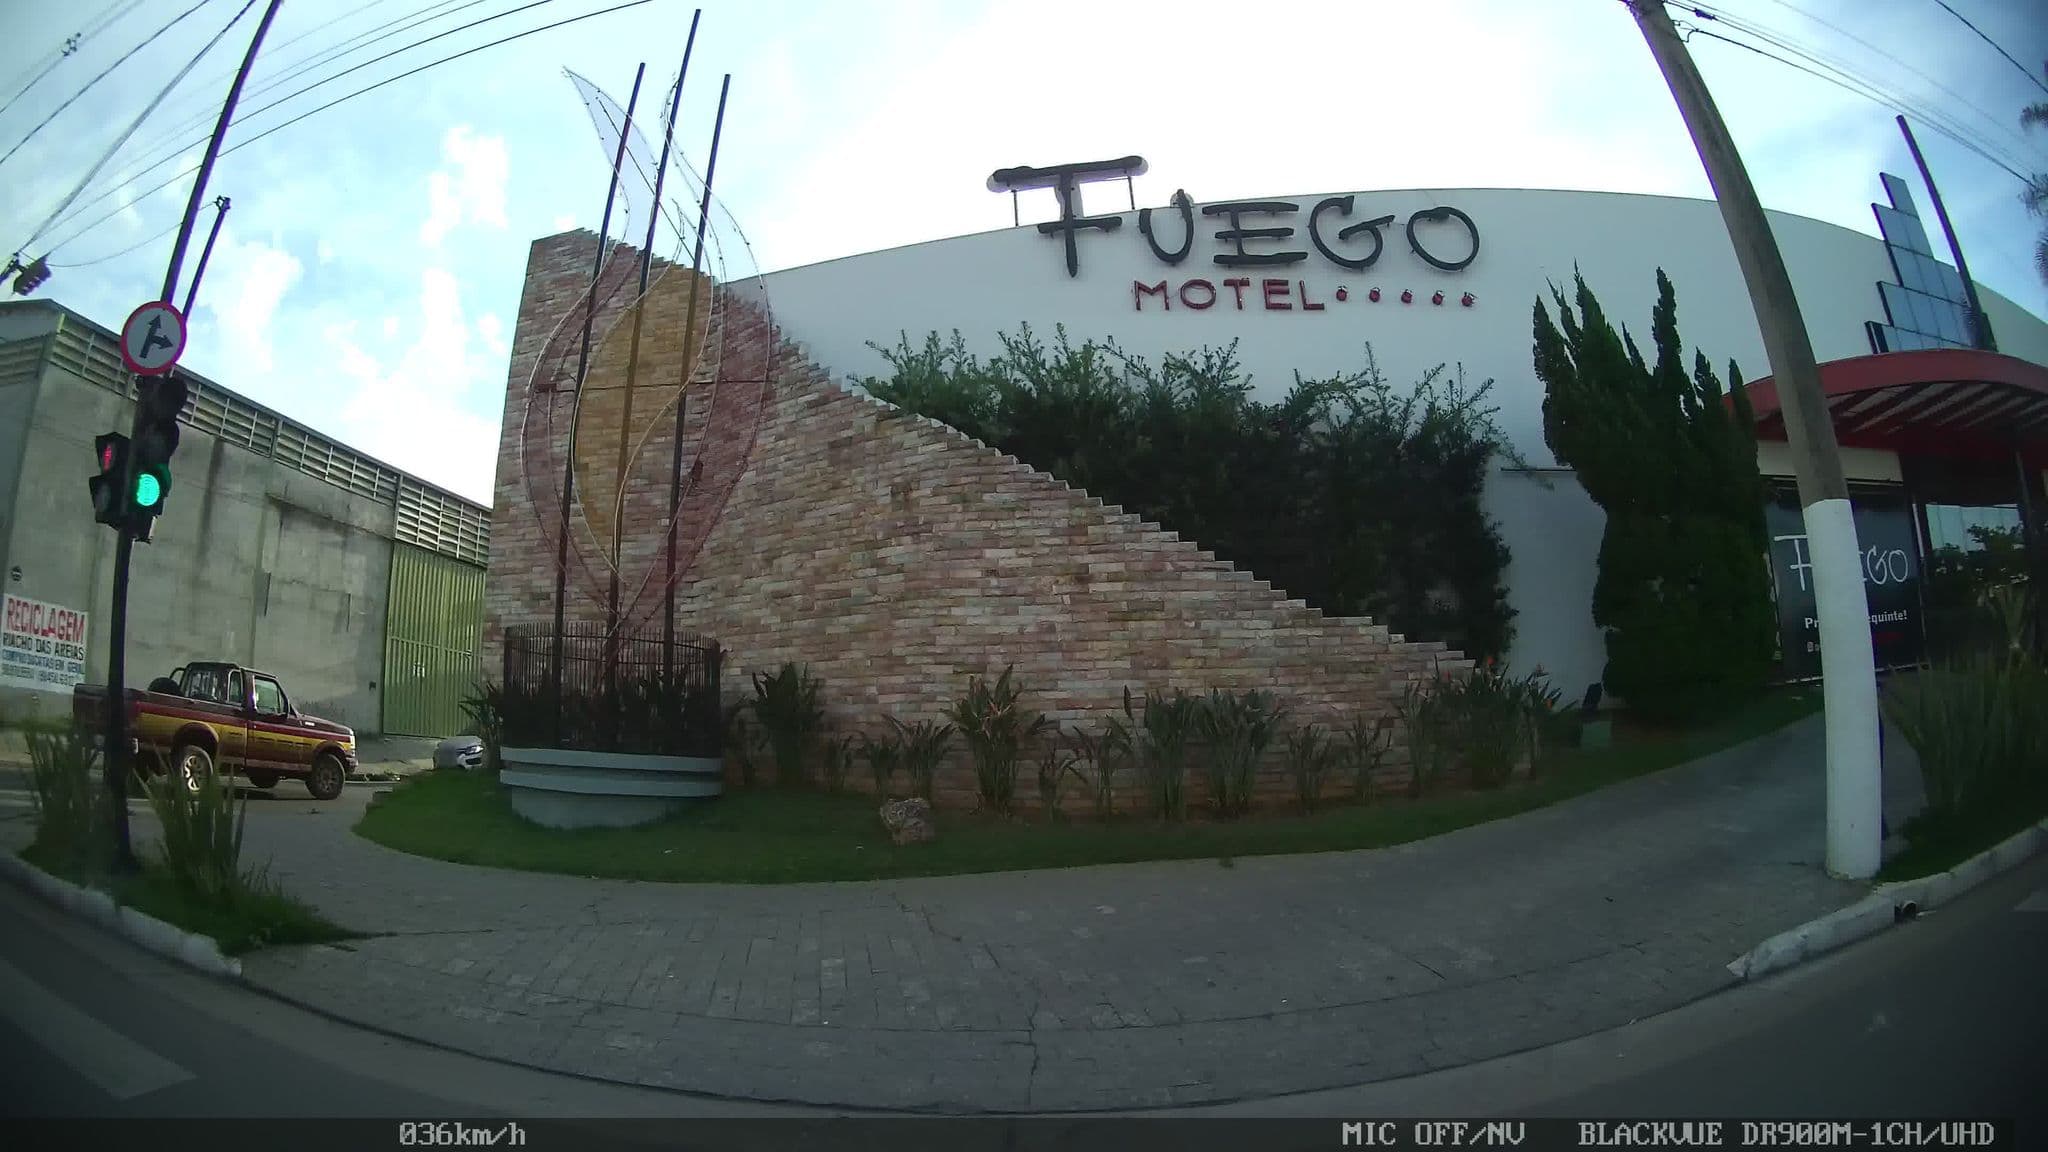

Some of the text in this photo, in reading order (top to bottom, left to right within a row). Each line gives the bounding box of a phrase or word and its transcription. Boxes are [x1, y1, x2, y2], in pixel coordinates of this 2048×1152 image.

[992, 156, 1480, 278] FUEGO
[1134, 278, 1325, 310] MOTEL
[1774, 534, 1909, 591] FGO
[7, 598, 85, 645] RECICLAGEM
[3, 632, 84, 661] RIACHO DAS AREIAS
